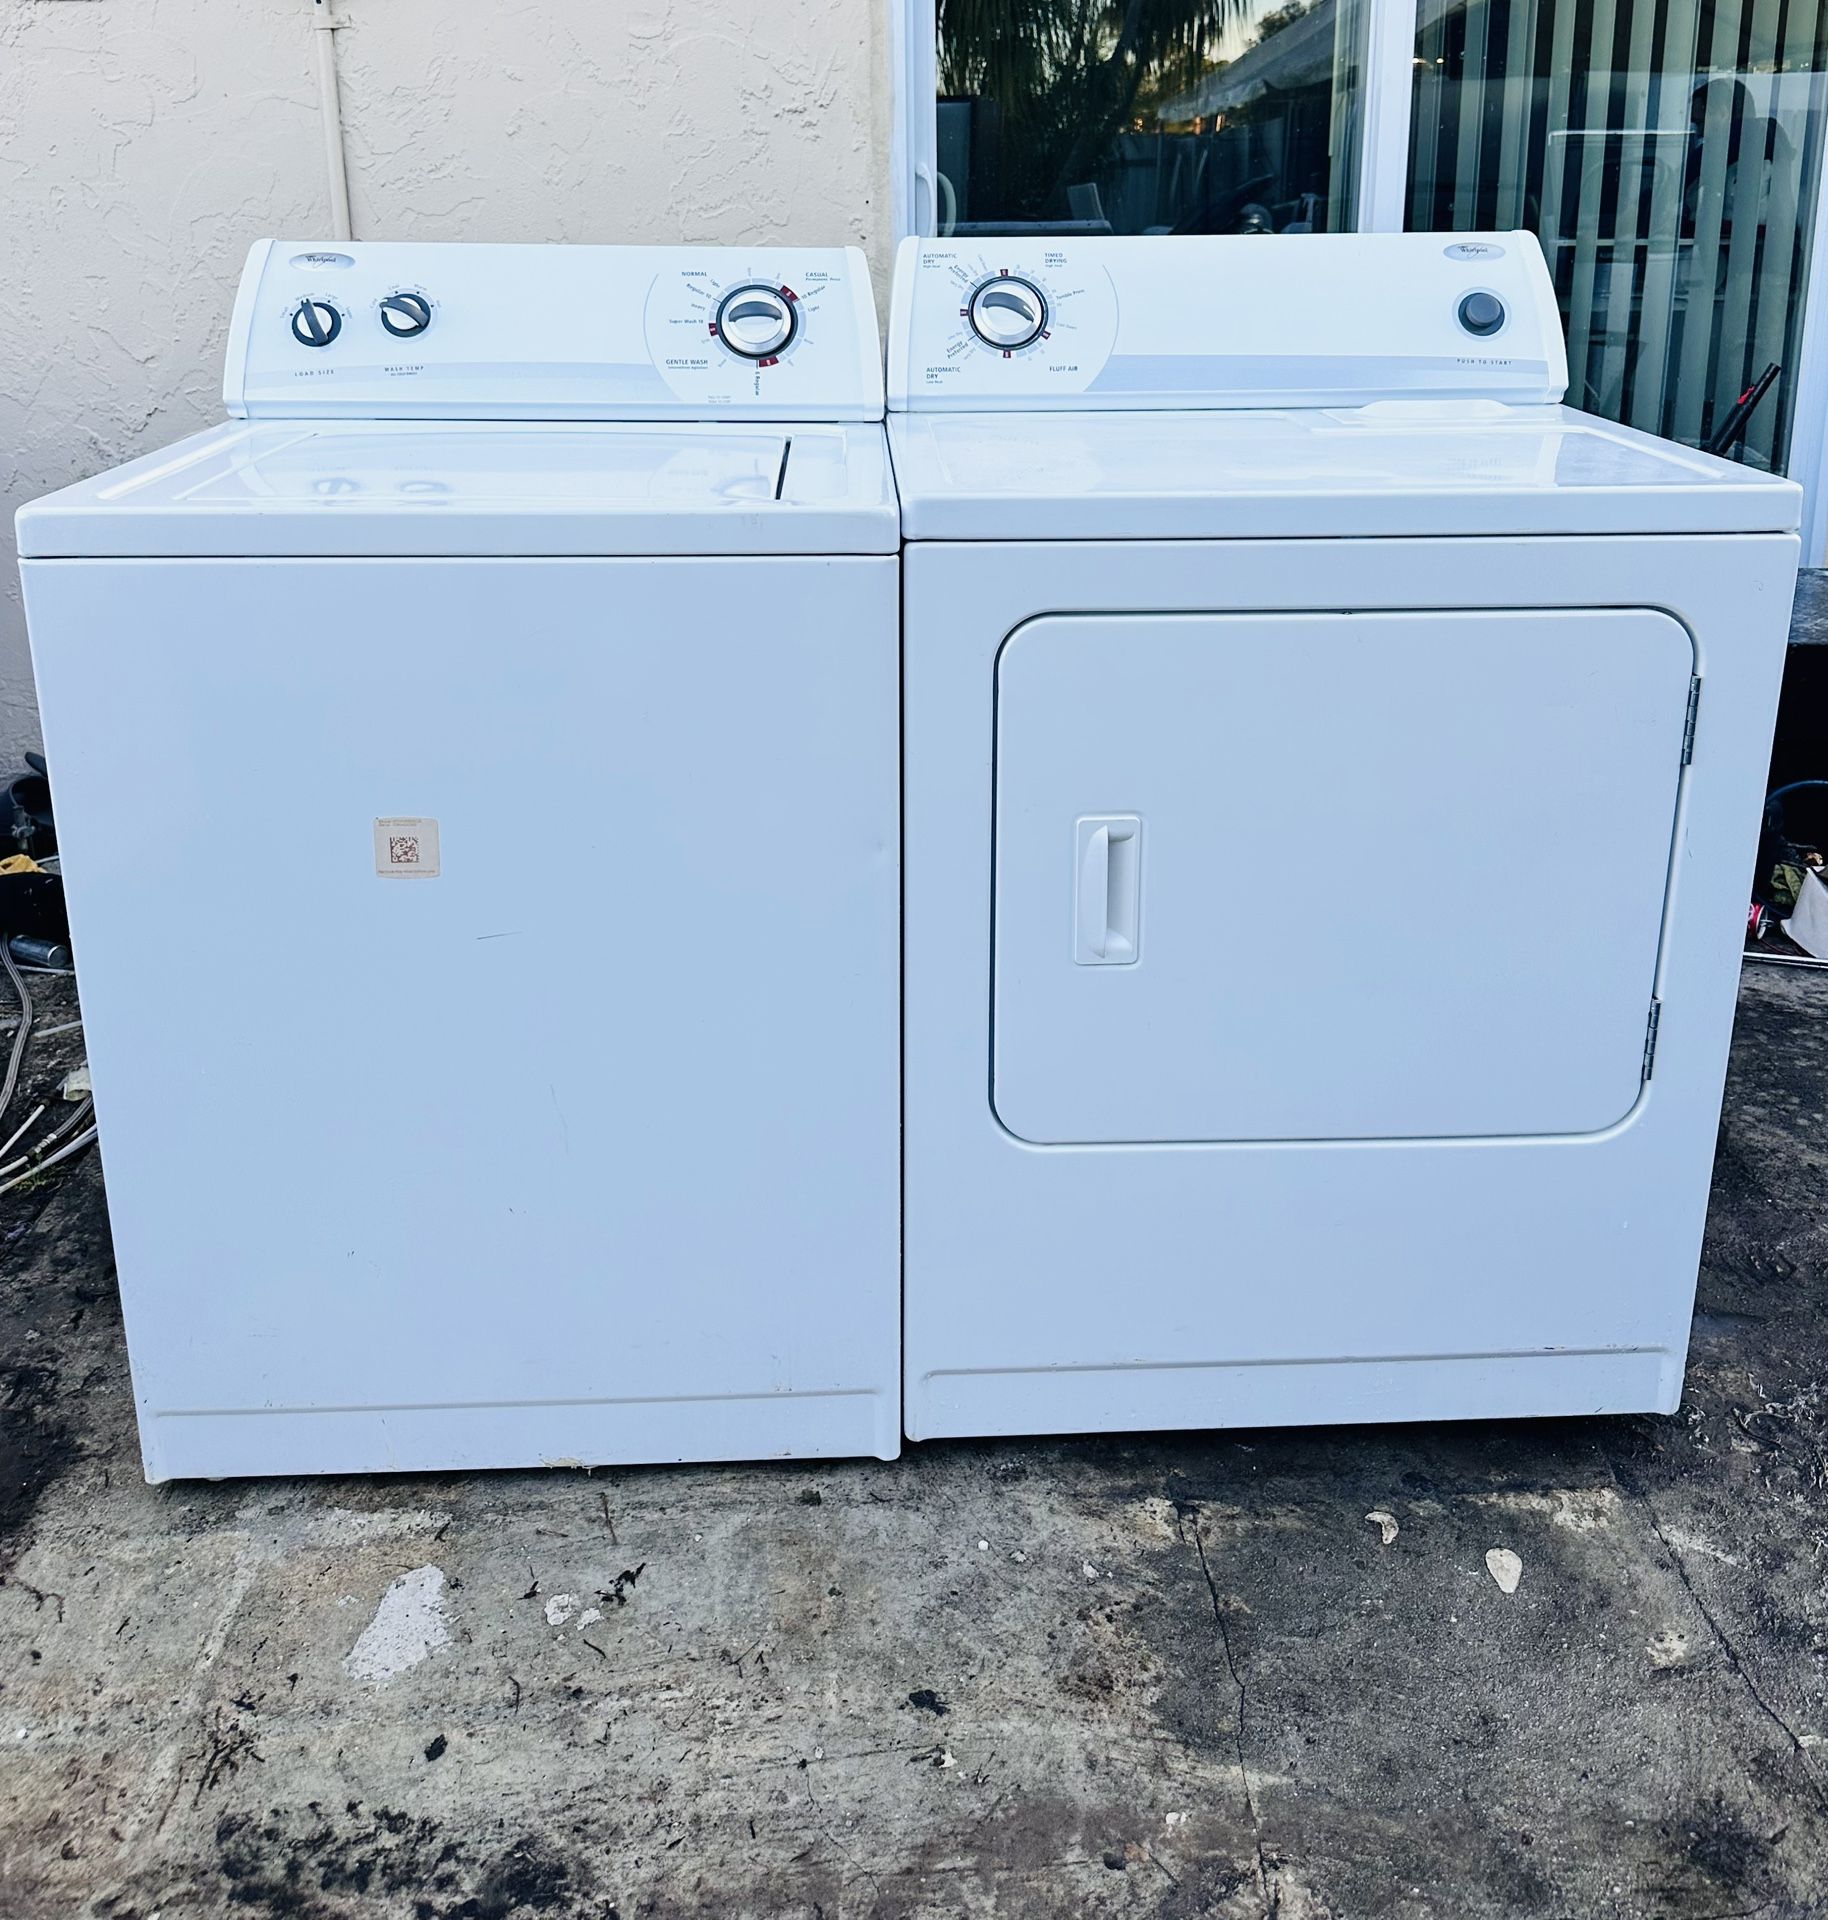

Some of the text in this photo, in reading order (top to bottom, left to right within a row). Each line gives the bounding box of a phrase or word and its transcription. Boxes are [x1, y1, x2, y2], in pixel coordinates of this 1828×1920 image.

[1458, 246, 1488, 258] Whirlpool
[305, 255, 337, 268] Whirlpool
[686, 283, 704, 295] Regular
[808, 285, 826, 296] Regular
[946, 341, 963, 353] Energy
[947, 342, 968, 359] Preferred
